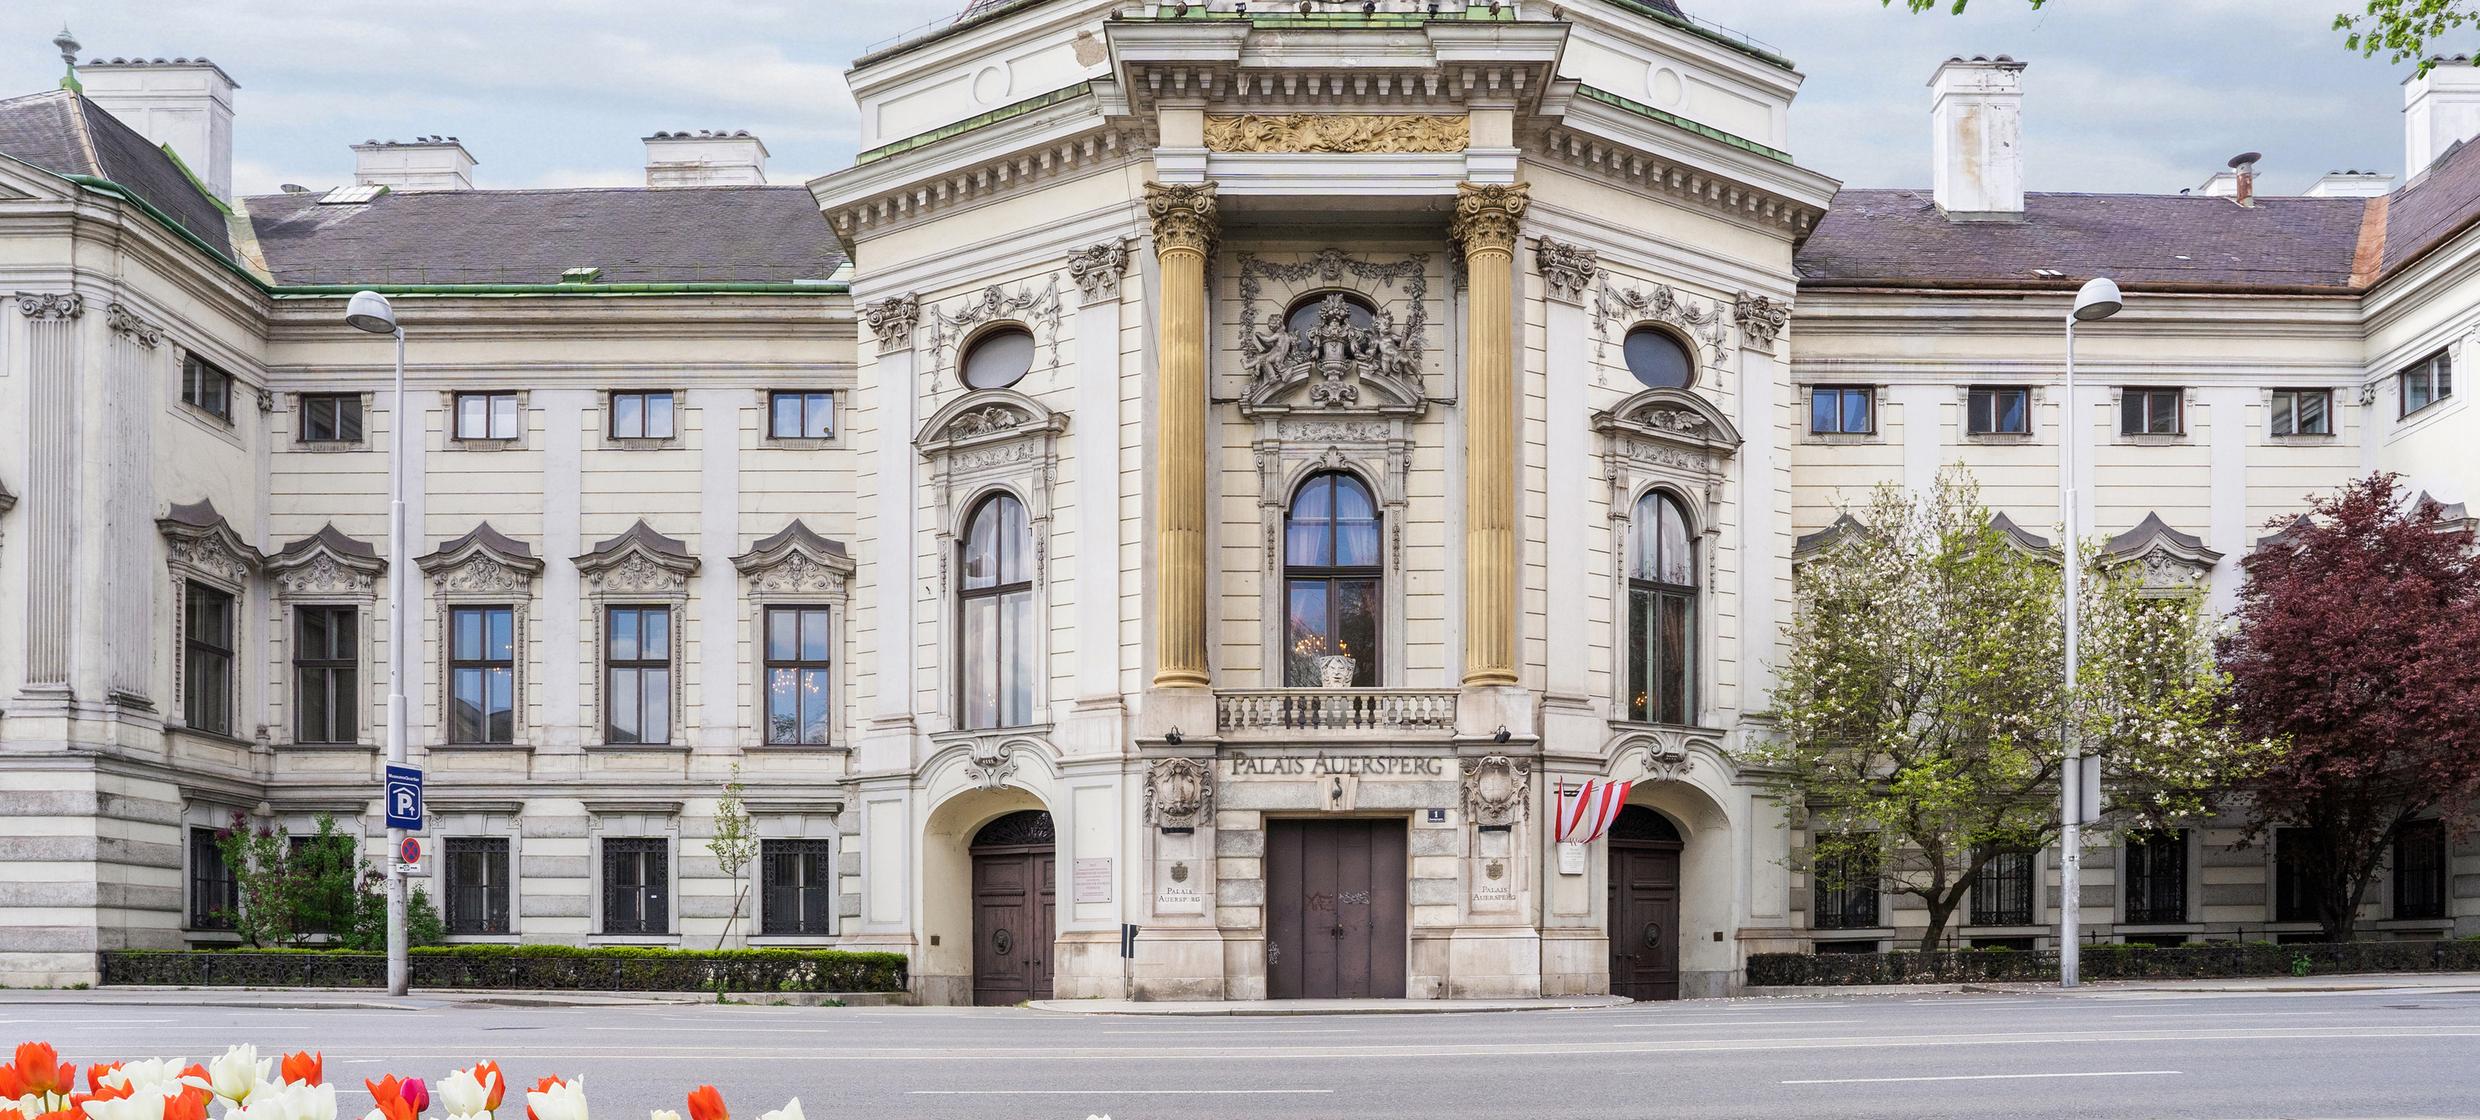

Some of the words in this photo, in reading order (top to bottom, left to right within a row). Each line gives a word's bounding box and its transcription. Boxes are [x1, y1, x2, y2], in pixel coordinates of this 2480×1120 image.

[1232, 751, 1304, 775] PALAIS
[1312, 751, 1442, 775] AUERSPERG
[398, 793, 412, 815] P
[1158, 895, 1201, 903] AUERSPRG
